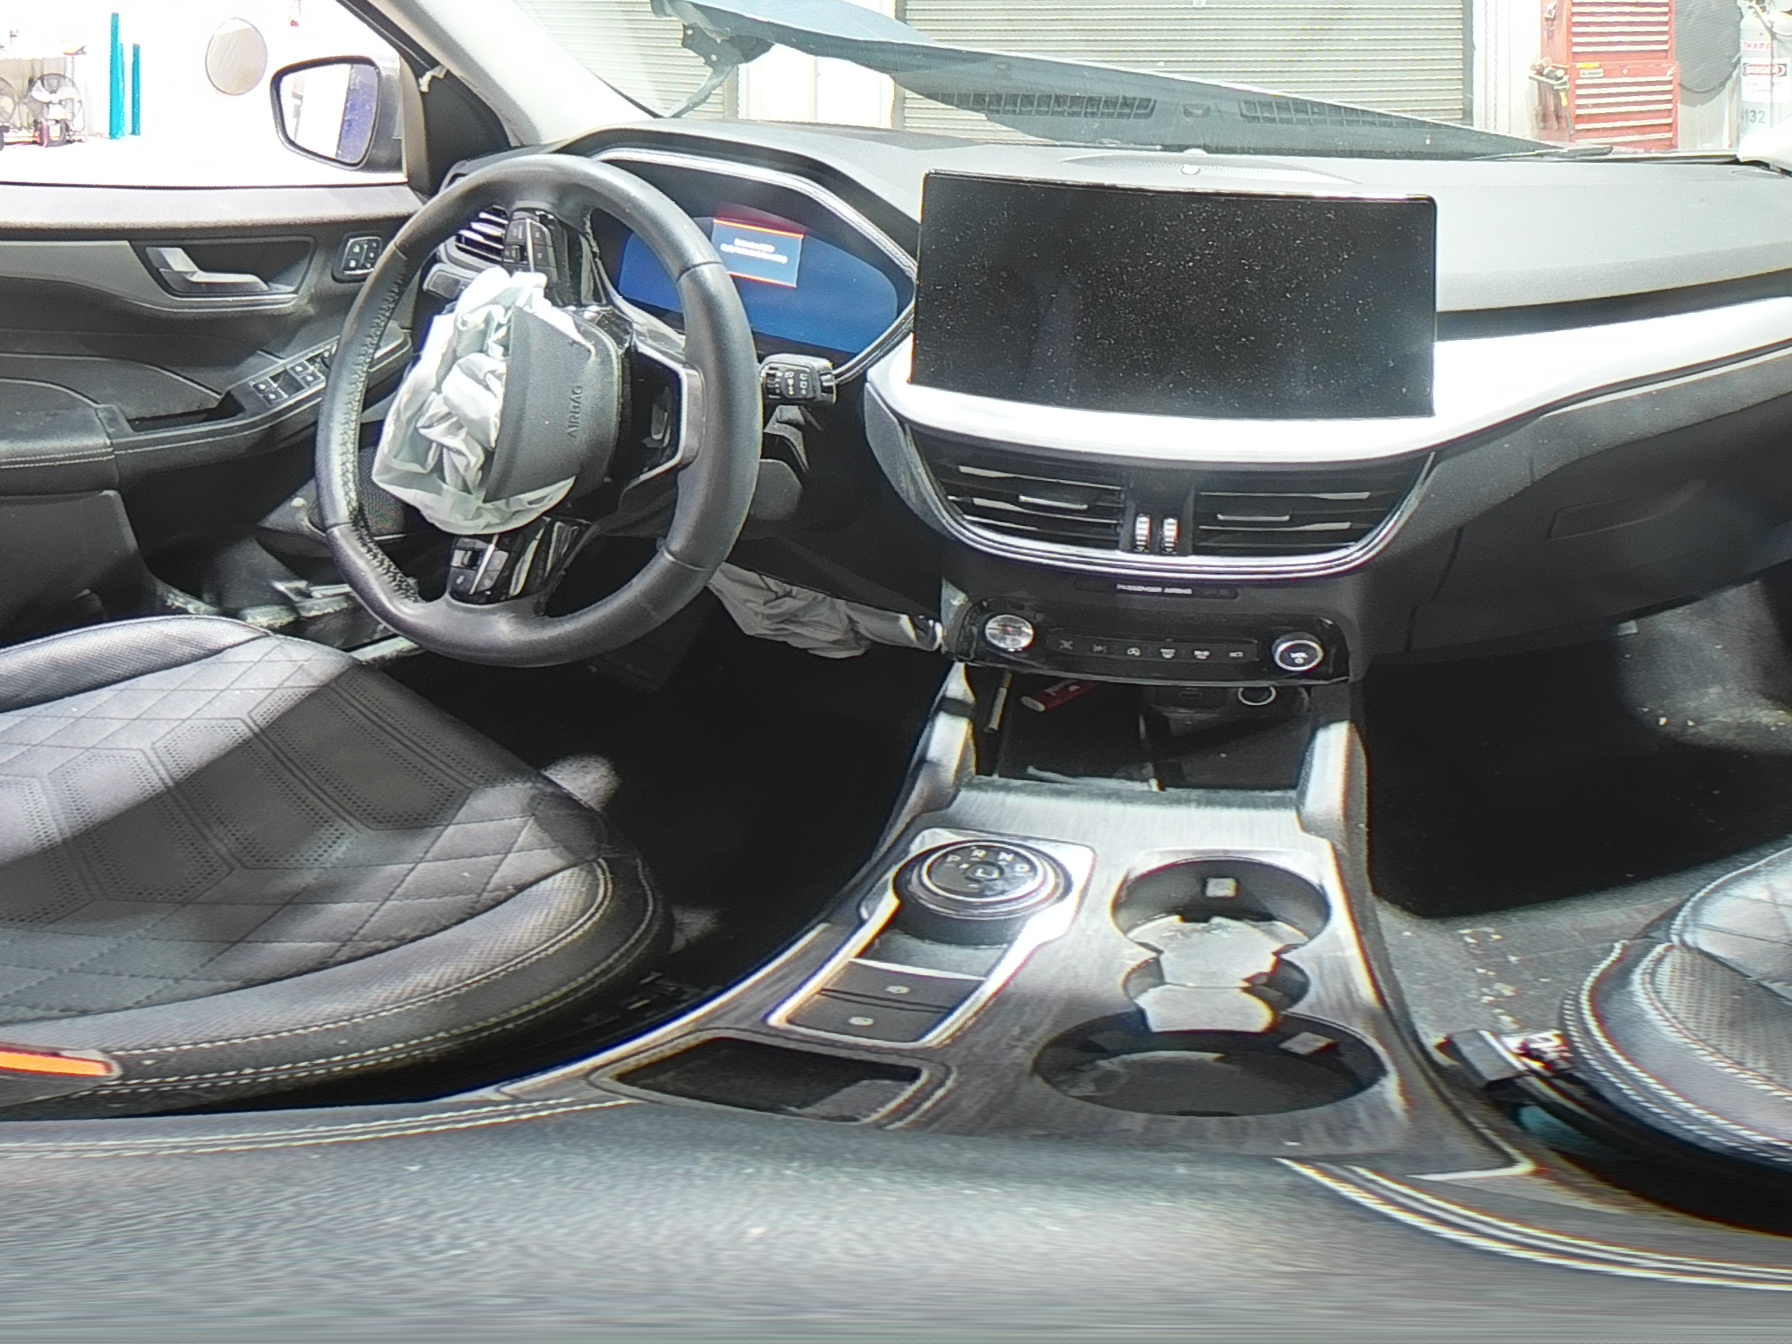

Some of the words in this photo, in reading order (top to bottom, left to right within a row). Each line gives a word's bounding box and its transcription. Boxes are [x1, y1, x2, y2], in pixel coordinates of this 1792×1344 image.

[566, 384, 585, 441] AIRBAG
[945, 854, 961, 863] P
[971, 848, 988, 858] R
[998, 851, 1015, 862] N
